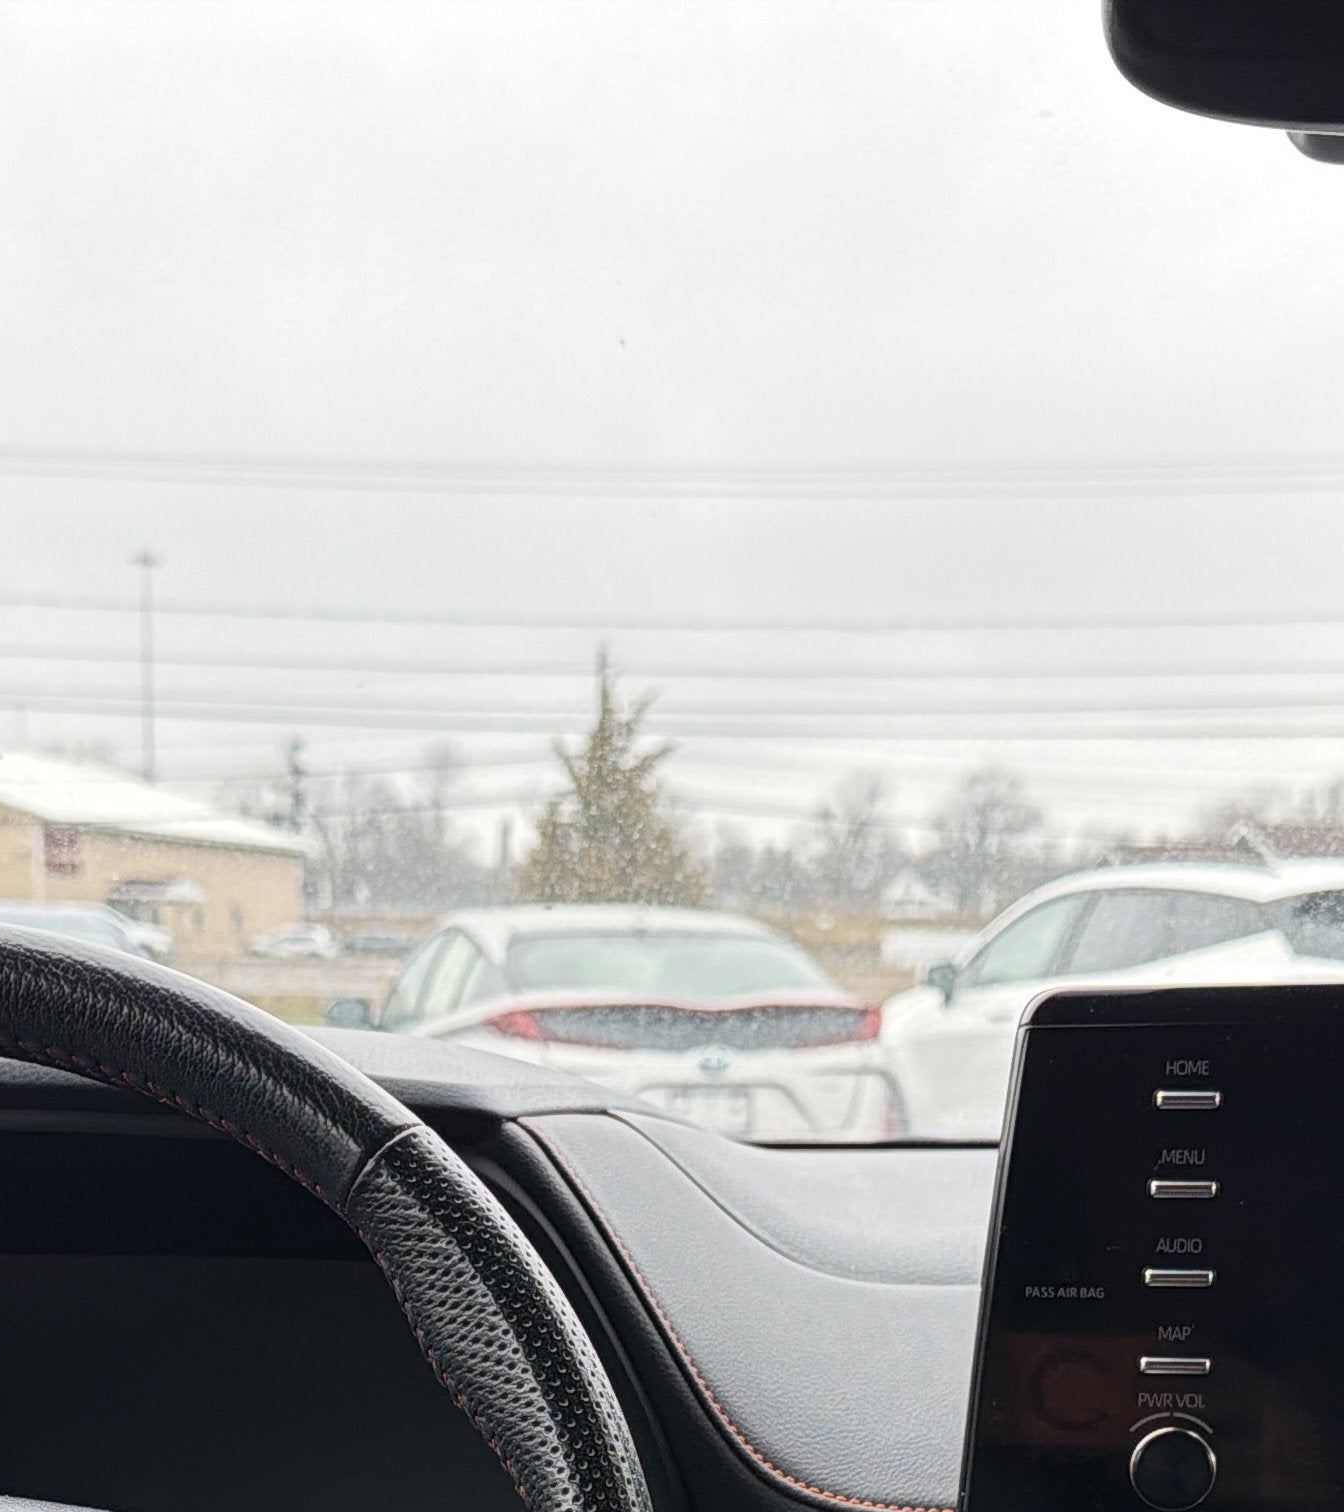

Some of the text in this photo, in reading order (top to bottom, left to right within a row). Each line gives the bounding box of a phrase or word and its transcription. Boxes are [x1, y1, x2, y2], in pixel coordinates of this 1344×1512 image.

[1166, 1060, 1209, 1076] HOME
[1160, 1150, 1205, 1165] MENU
[1156, 1238, 1202, 1254] AUDIO
[1025, 1287, 1105, 1299] PASS AIR BAG
[1158, 1326, 1191, 1341] MAP
[1137, 1392, 1206, 1408] PWR VOL
